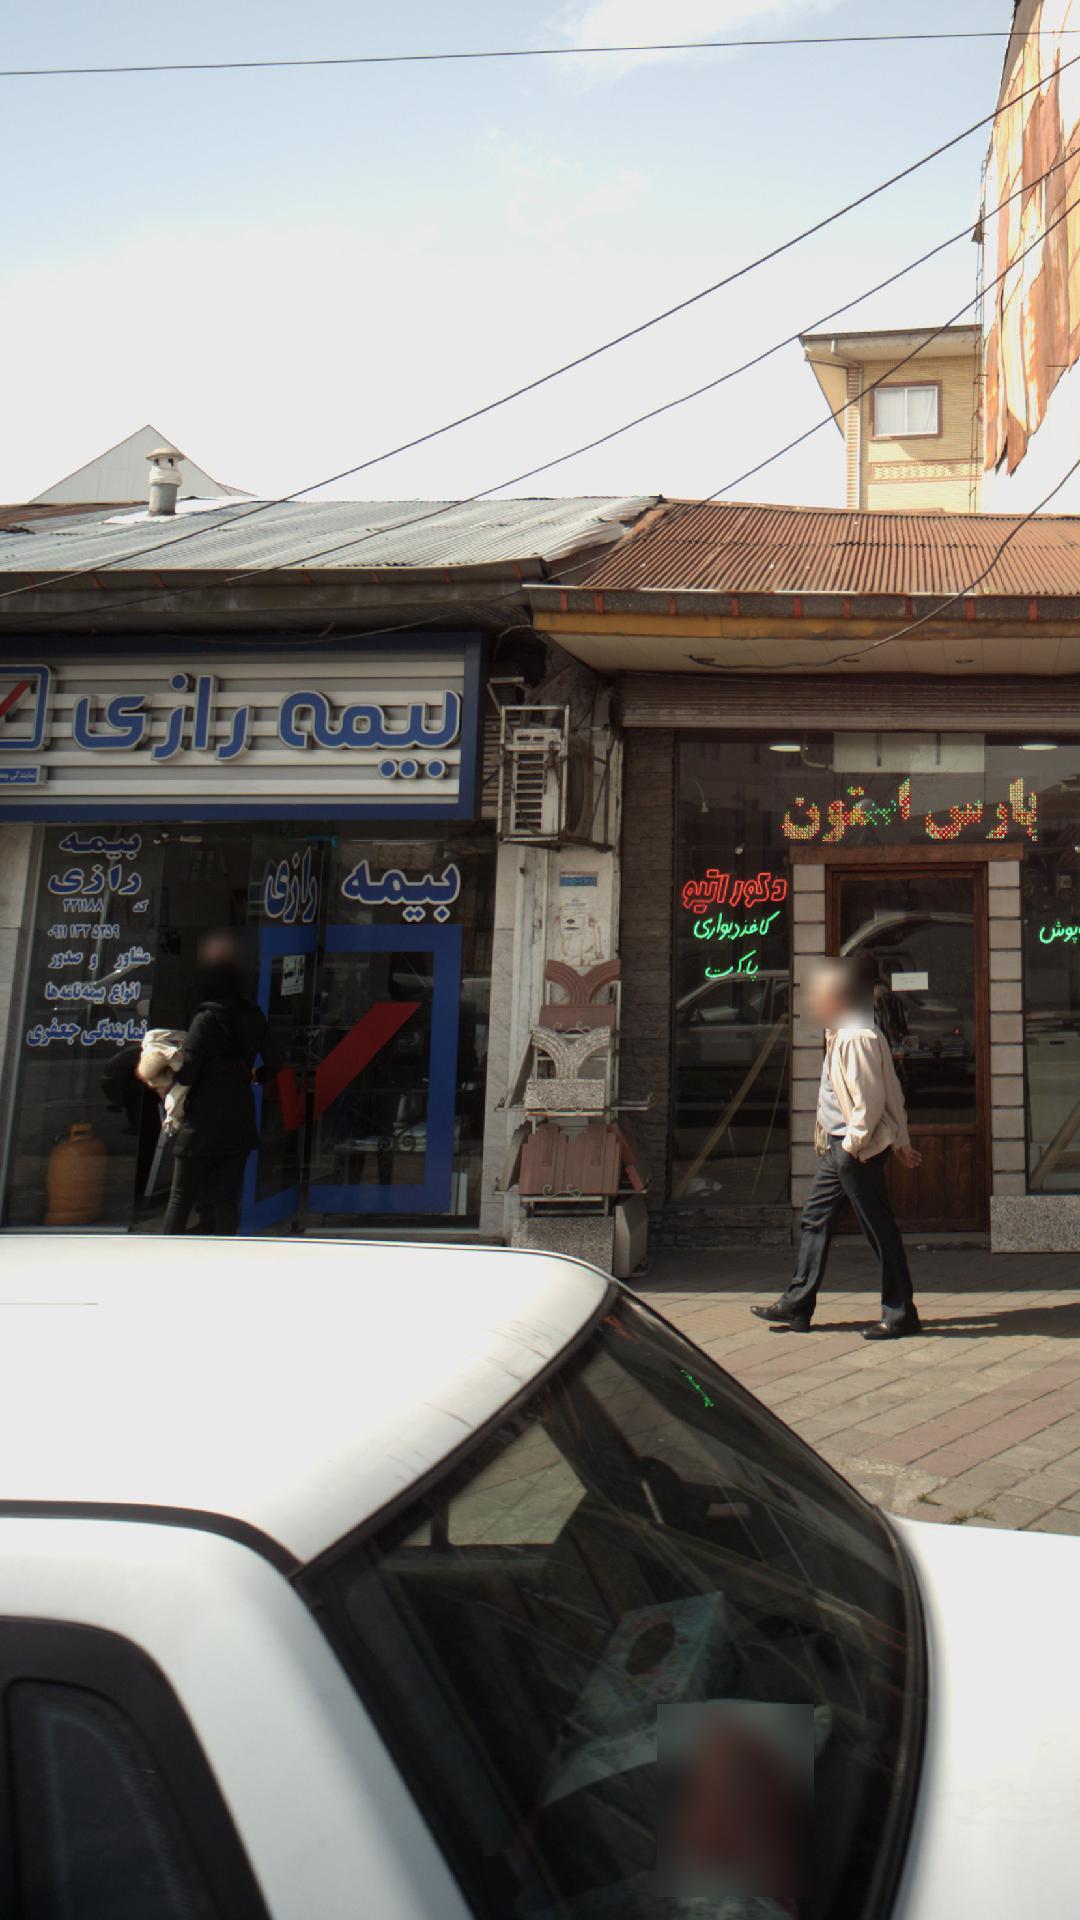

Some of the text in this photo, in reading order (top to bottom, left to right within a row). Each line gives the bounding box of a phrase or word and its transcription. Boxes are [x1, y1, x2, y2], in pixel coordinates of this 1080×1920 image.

[72, 671, 462, 780] بیمه رازی
[925, 777, 1039, 842] پارس
[59, 832, 142, 860] بیمه
[48, 864, 142, 894] رازی
[264, 846, 462, 923] بیمه رازی
[132, 899, 149, 913] کد
[1039, 919, 1080, 945] پوش
[48, 950, 84, 969] صدور
[88, 953, 98, 970] و
[108, 981, 141, 1004] انواع
[27, 1017, 148, 1047] نمایندگی جعفری
